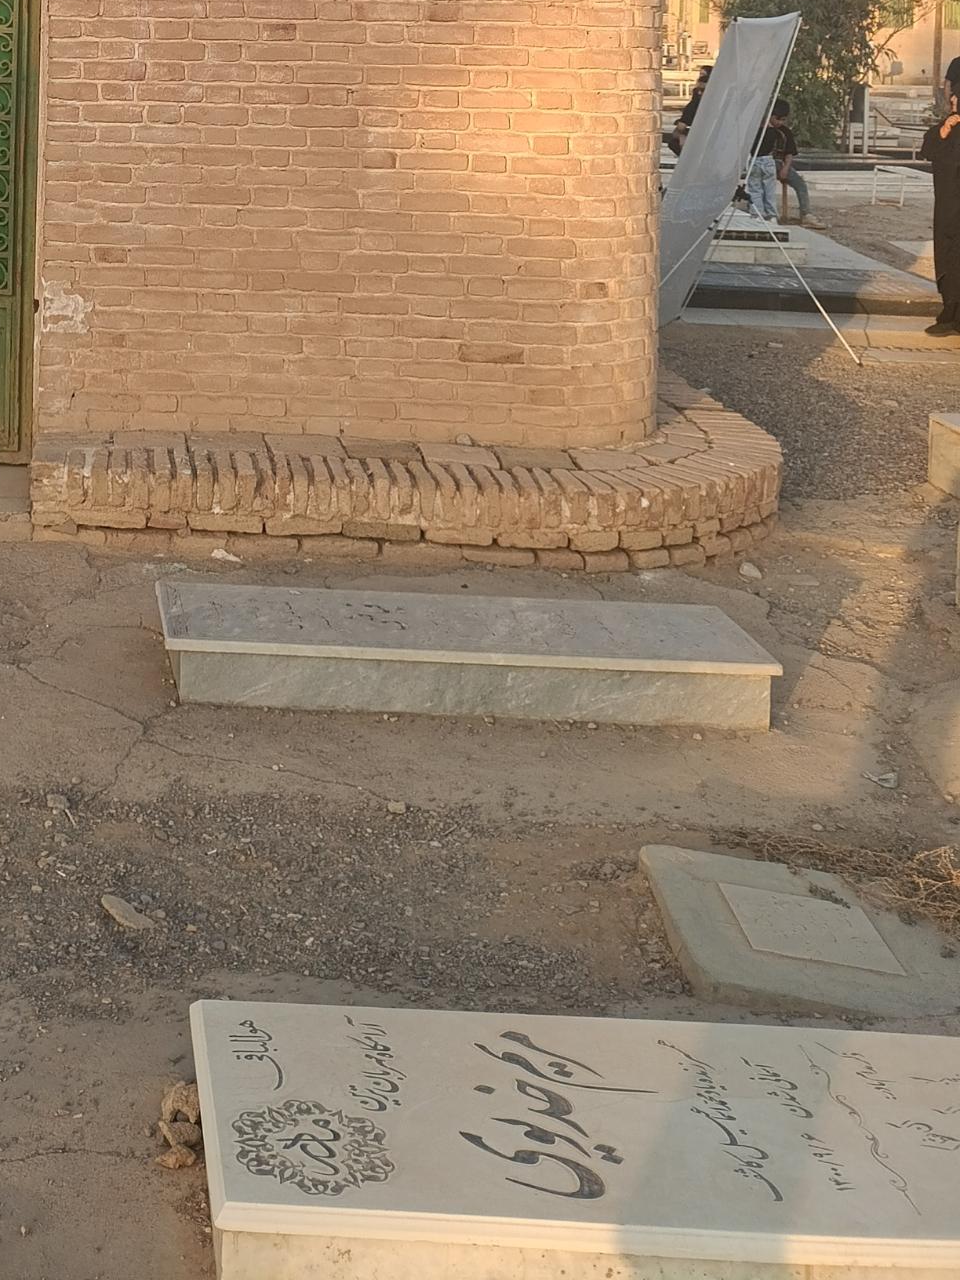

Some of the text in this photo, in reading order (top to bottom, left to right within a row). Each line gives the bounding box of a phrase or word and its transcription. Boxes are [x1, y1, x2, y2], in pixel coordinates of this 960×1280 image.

[344, 1015, 407, 1111] آرامگاه مهربان ترین
[740, 1057, 814, 1118] آسمانی شدن
[276, 1119, 341, 1176] مادر
[459, 1030, 660, 1199] مریم خدیوی
[657, 1039, 715, 1070] همسر
[722, 1150, 783, 1201] کاشف
